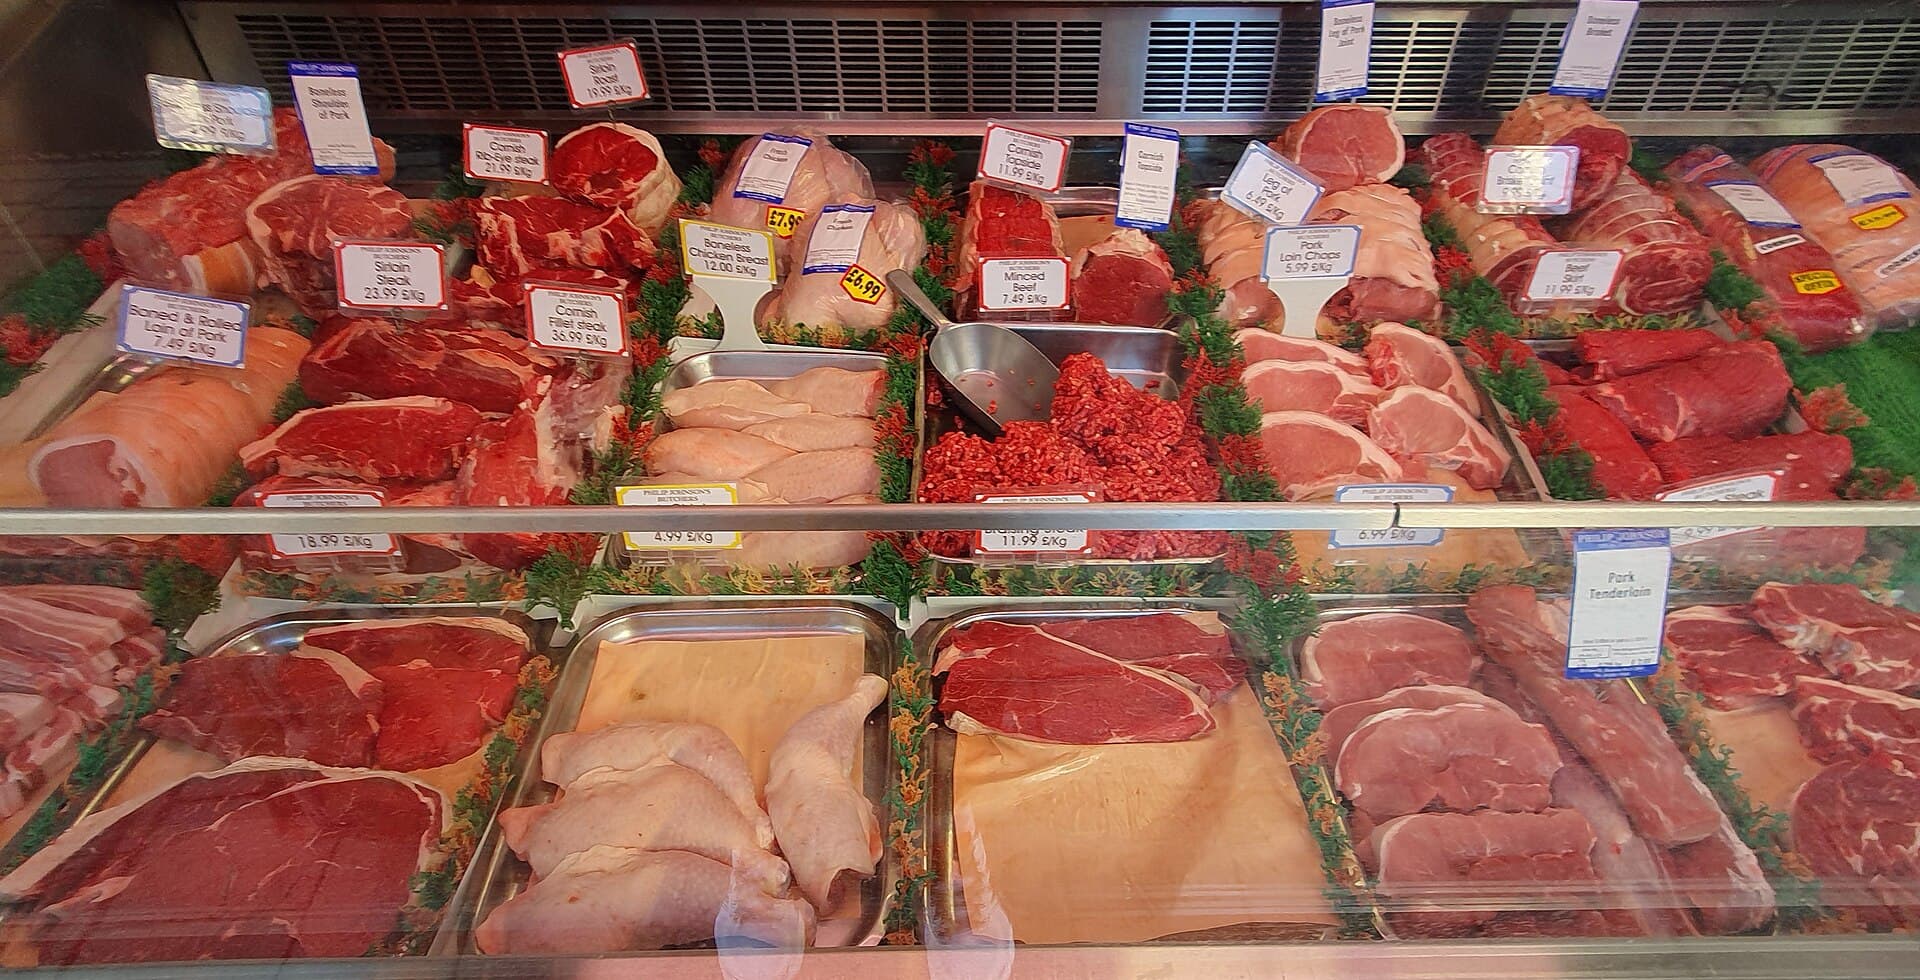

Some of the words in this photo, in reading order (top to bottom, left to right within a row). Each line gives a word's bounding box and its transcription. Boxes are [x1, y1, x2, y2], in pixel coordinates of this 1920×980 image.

[589, 63, 617, 75] Sirloin
[592, 74, 619, 86] Roast
[587, 86, 611, 99] 19.99
[312, 98, 350, 109] Shoulder
[319, 110, 328, 120] of
[329, 110, 351, 120] Pork
[489, 141, 527, 154] Cornish
[1007, 143, 1044, 159] Cornish
[514, 154, 540, 166] steak
[1005, 154, 1041, 170] Topside
[484, 163, 512, 176] 21.99
[999, 163, 1024, 178] 11.99
[1026, 170, 1045, 185] £/Kg
[1263, 173, 1281, 190] Leg
[1281, 186, 1293, 195] of
[704, 239, 751, 252] Boneless
[1301, 240, 1323, 250] Pork
[688, 247, 735, 262] Chicken
[736, 254, 769, 266] Breast
[1280, 252, 1302, 262] Loin
[1305, 250, 1342, 262] Chops
[374, 260, 412, 273] Sirloin
[704, 260, 734, 273] 12.00
[736, 265, 757, 277] £/Kg
[1285, 262, 1309, 273] 5.99
[1565, 263, 1591, 273] Beef
[376, 274, 412, 287] Steak
[1004, 272, 1045, 281] Minced
[846, 269, 881, 299] £6.99
[1013, 283, 1037, 292] Beef
[1545, 285, 1573, 295] 11.99
[364, 287, 398, 300] 23.99
[402, 290, 426, 303] £/Kg
[1003, 294, 1025, 304] 7.49
[1027, 294, 1048, 305] £/Kg
[129, 304, 179, 322] Boned
[183, 313, 195, 325] &
[198, 315, 242, 332] Rolled
[555, 305, 598, 318] Cornish
[144, 320, 175, 335] Loin
[179, 327, 194, 338] of
[197, 328, 228, 343] Pork
[548, 317, 576, 331] Fillet
[577, 320, 608, 333] steak
[154, 335, 185, 351] 7.49
[552, 330, 583, 344] 36.99
[586, 333, 608, 348] £/Kg
[654, 531, 682, 543] 4.99
[687, 531, 713, 544] £/Kg
[1002, 535, 1038, 547] 11.99
[1042, 536, 1068, 548] £/Kg
[1359, 529, 1387, 540] 6.99
[1391, 529, 1417, 541] £/Kg
[298, 535, 339, 549] 18.99
[343, 536, 373, 549] £/Kg
[1608, 571, 1636, 583] Pork
[1590, 586, 1652, 599] Tenderloin
